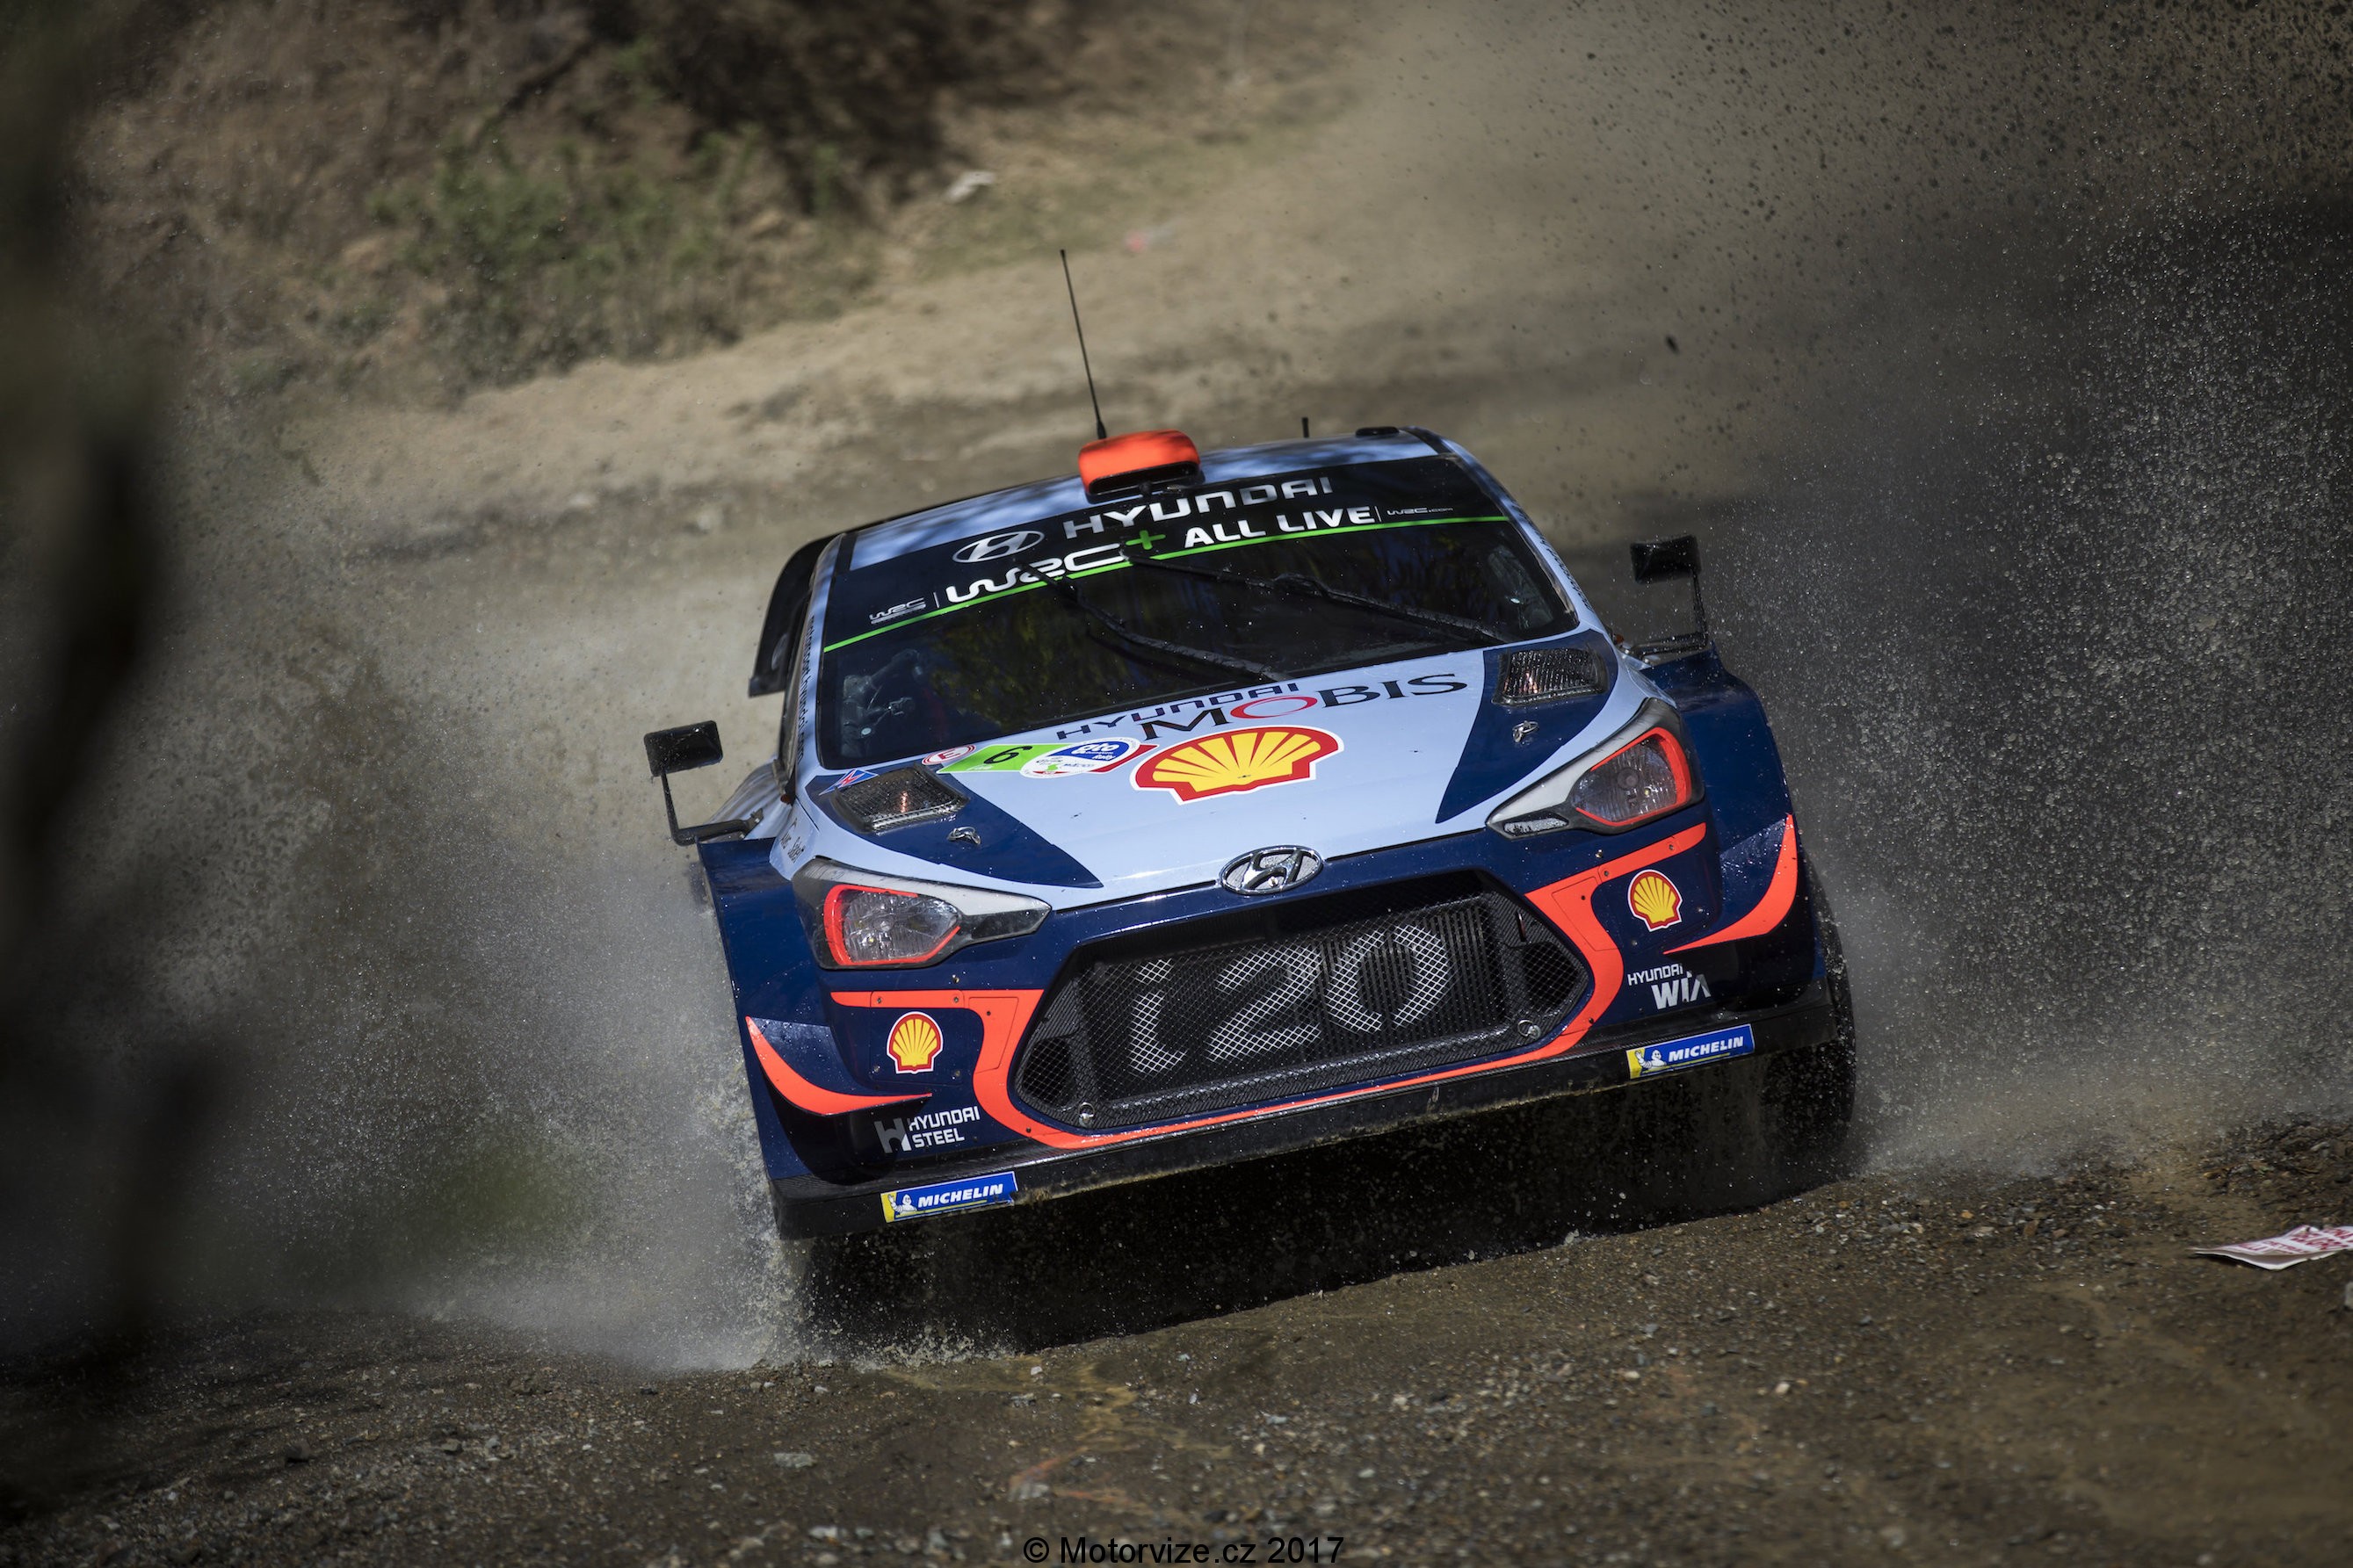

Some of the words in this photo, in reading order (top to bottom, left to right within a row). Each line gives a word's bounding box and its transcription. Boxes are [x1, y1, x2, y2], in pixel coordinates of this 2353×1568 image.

[1063, 477, 1334, 539] HYUNDAI
[1184, 520, 1266, 549] ALL
[1277, 505, 1376, 532] LIVE
[869, 597, 926, 621] WRC
[1056, 683, 1299, 741] HYUNDAI
[1141, 673, 1468, 743] MOBIS
[982, 746, 1033, 765] 6
[1627, 963, 1684, 986] HYUNDAI
[1129, 924, 1450, 1075] i20
[1651, 971, 1712, 1010] WIA
[1669, 1036, 1745, 1063] MICHELIN
[907, 1105, 981, 1131] HYUNDAI
[911, 1127, 966, 1149] STEEL
[917, 1183, 1004, 1209] MICHELIN
